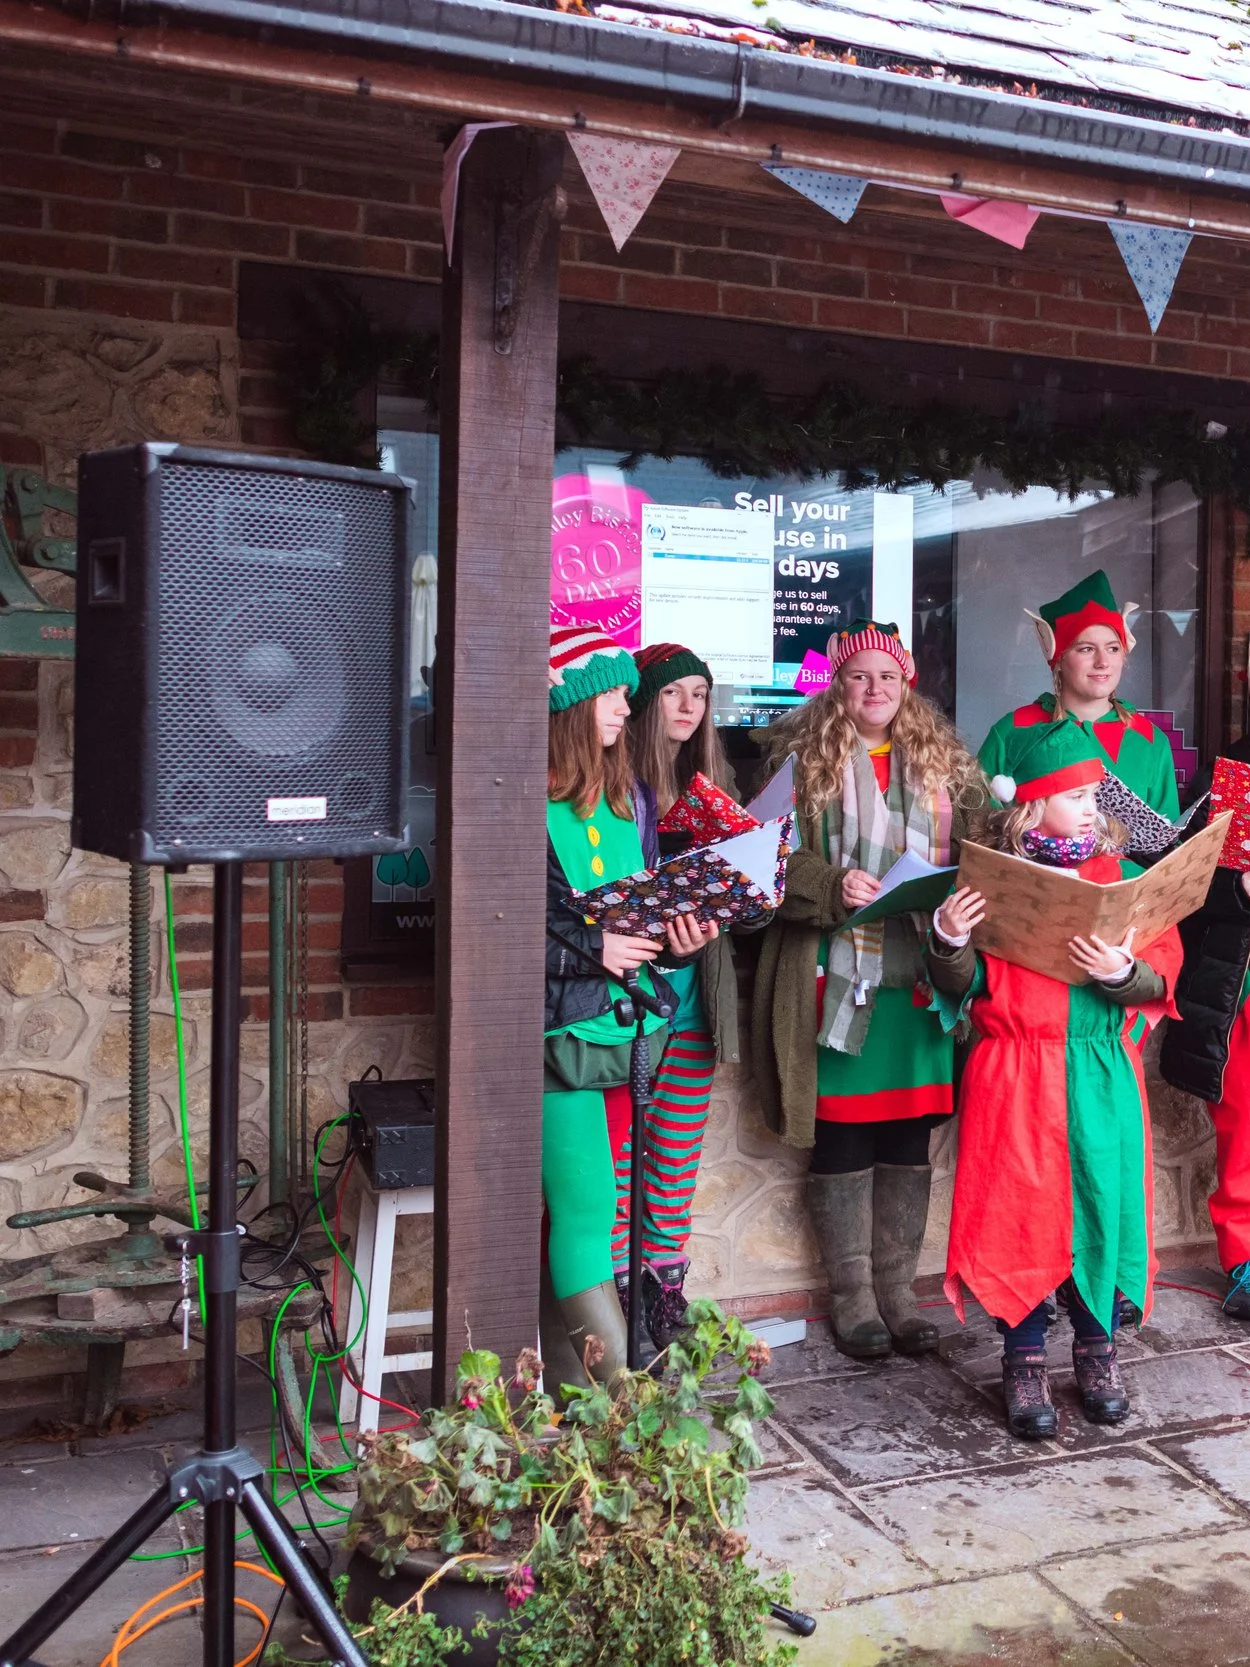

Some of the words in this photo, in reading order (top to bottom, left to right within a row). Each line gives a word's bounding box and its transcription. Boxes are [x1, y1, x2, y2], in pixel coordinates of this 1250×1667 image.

[735, 491, 784, 517] Sell
[791, 501, 851, 524] your
[824, 526, 848, 551] in
[553, 540, 621, 583] 60
[778, 554, 840, 584] days
[562, 577, 621, 605] DAY
[785, 590, 796, 599] us
[798, 590, 809, 599] to
[811, 591, 827, 600] sell
[789, 602, 798, 611] in
[800, 602, 814, 611] 60
[816, 603, 841, 615] days,
[814, 616, 825, 625] to
[780, 626, 798, 636] fee.
